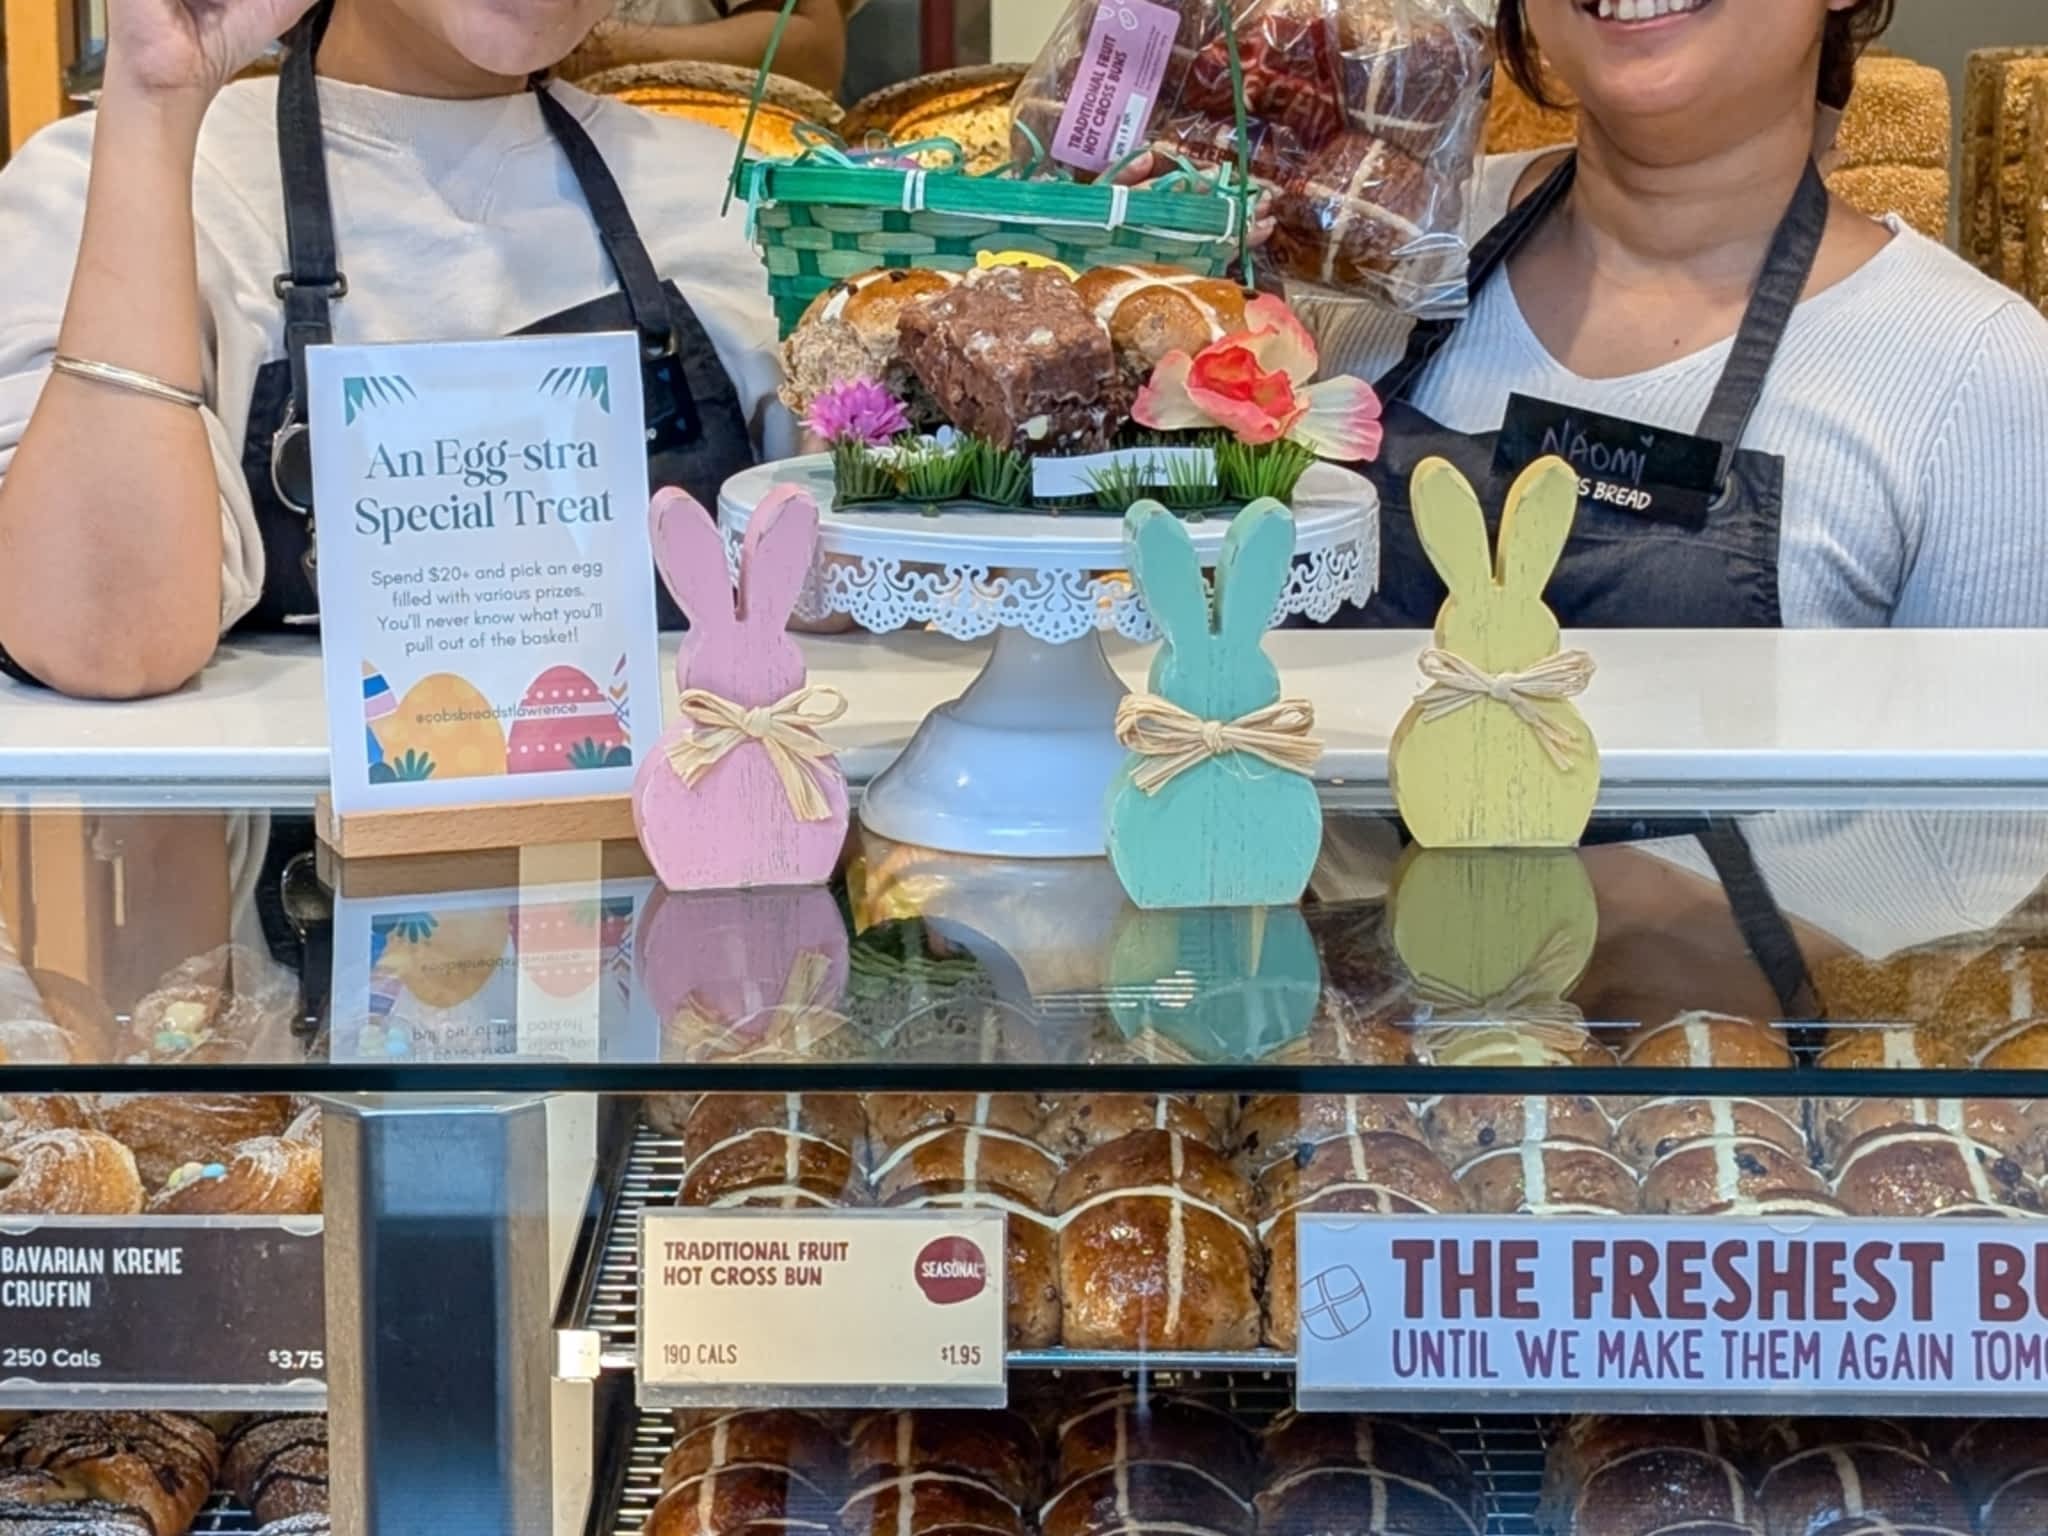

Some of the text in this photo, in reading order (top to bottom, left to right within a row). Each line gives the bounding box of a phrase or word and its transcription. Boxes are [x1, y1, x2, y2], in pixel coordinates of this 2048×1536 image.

[1068, 33, 1117, 149] TRADITIONAL FRUIT
[1081, 129, 1101, 156] HOT
[1092, 84, 1116, 128] CROSS
[1107, 50, 1127, 82] BUNS
[365, 438, 599, 488] An Egg-stra
[1576, 476, 1652, 510] S BREAD
[355, 488, 614, 545] Special Treat
[371, 561, 603, 588] Spend $20+ and pick an egg
[392, 585, 585, 608] filled with various prizes.
[377, 602, 603, 631] You'll never know what you'll
[405, 627, 580, 656] pull out of the basket!
[0, 1246, 184, 1275] BAVARIAN KREME
[663, 1241, 849, 1262] TRADITIONAL FRUIT
[663, 1266, 823, 1286] HOT CROSS BUN
[921, 1261, 981, 1279] SEASONAL
[1391, 1238, 1541, 1320] THE
[1572, 1239, 1945, 1322] FRESHEST
[2, 1280, 91, 1308] CRUFFIN
[2, 1348, 101, 1369] 250 Cals
[268, 1350, 324, 1369] $3.75
[663, 1343, 738, 1365] 190 CALS
[941, 1344, 982, 1366] $1.95
[1392, 1328, 2048, 1382] UNTIL WE MAKE THEM AGAIN TOM
